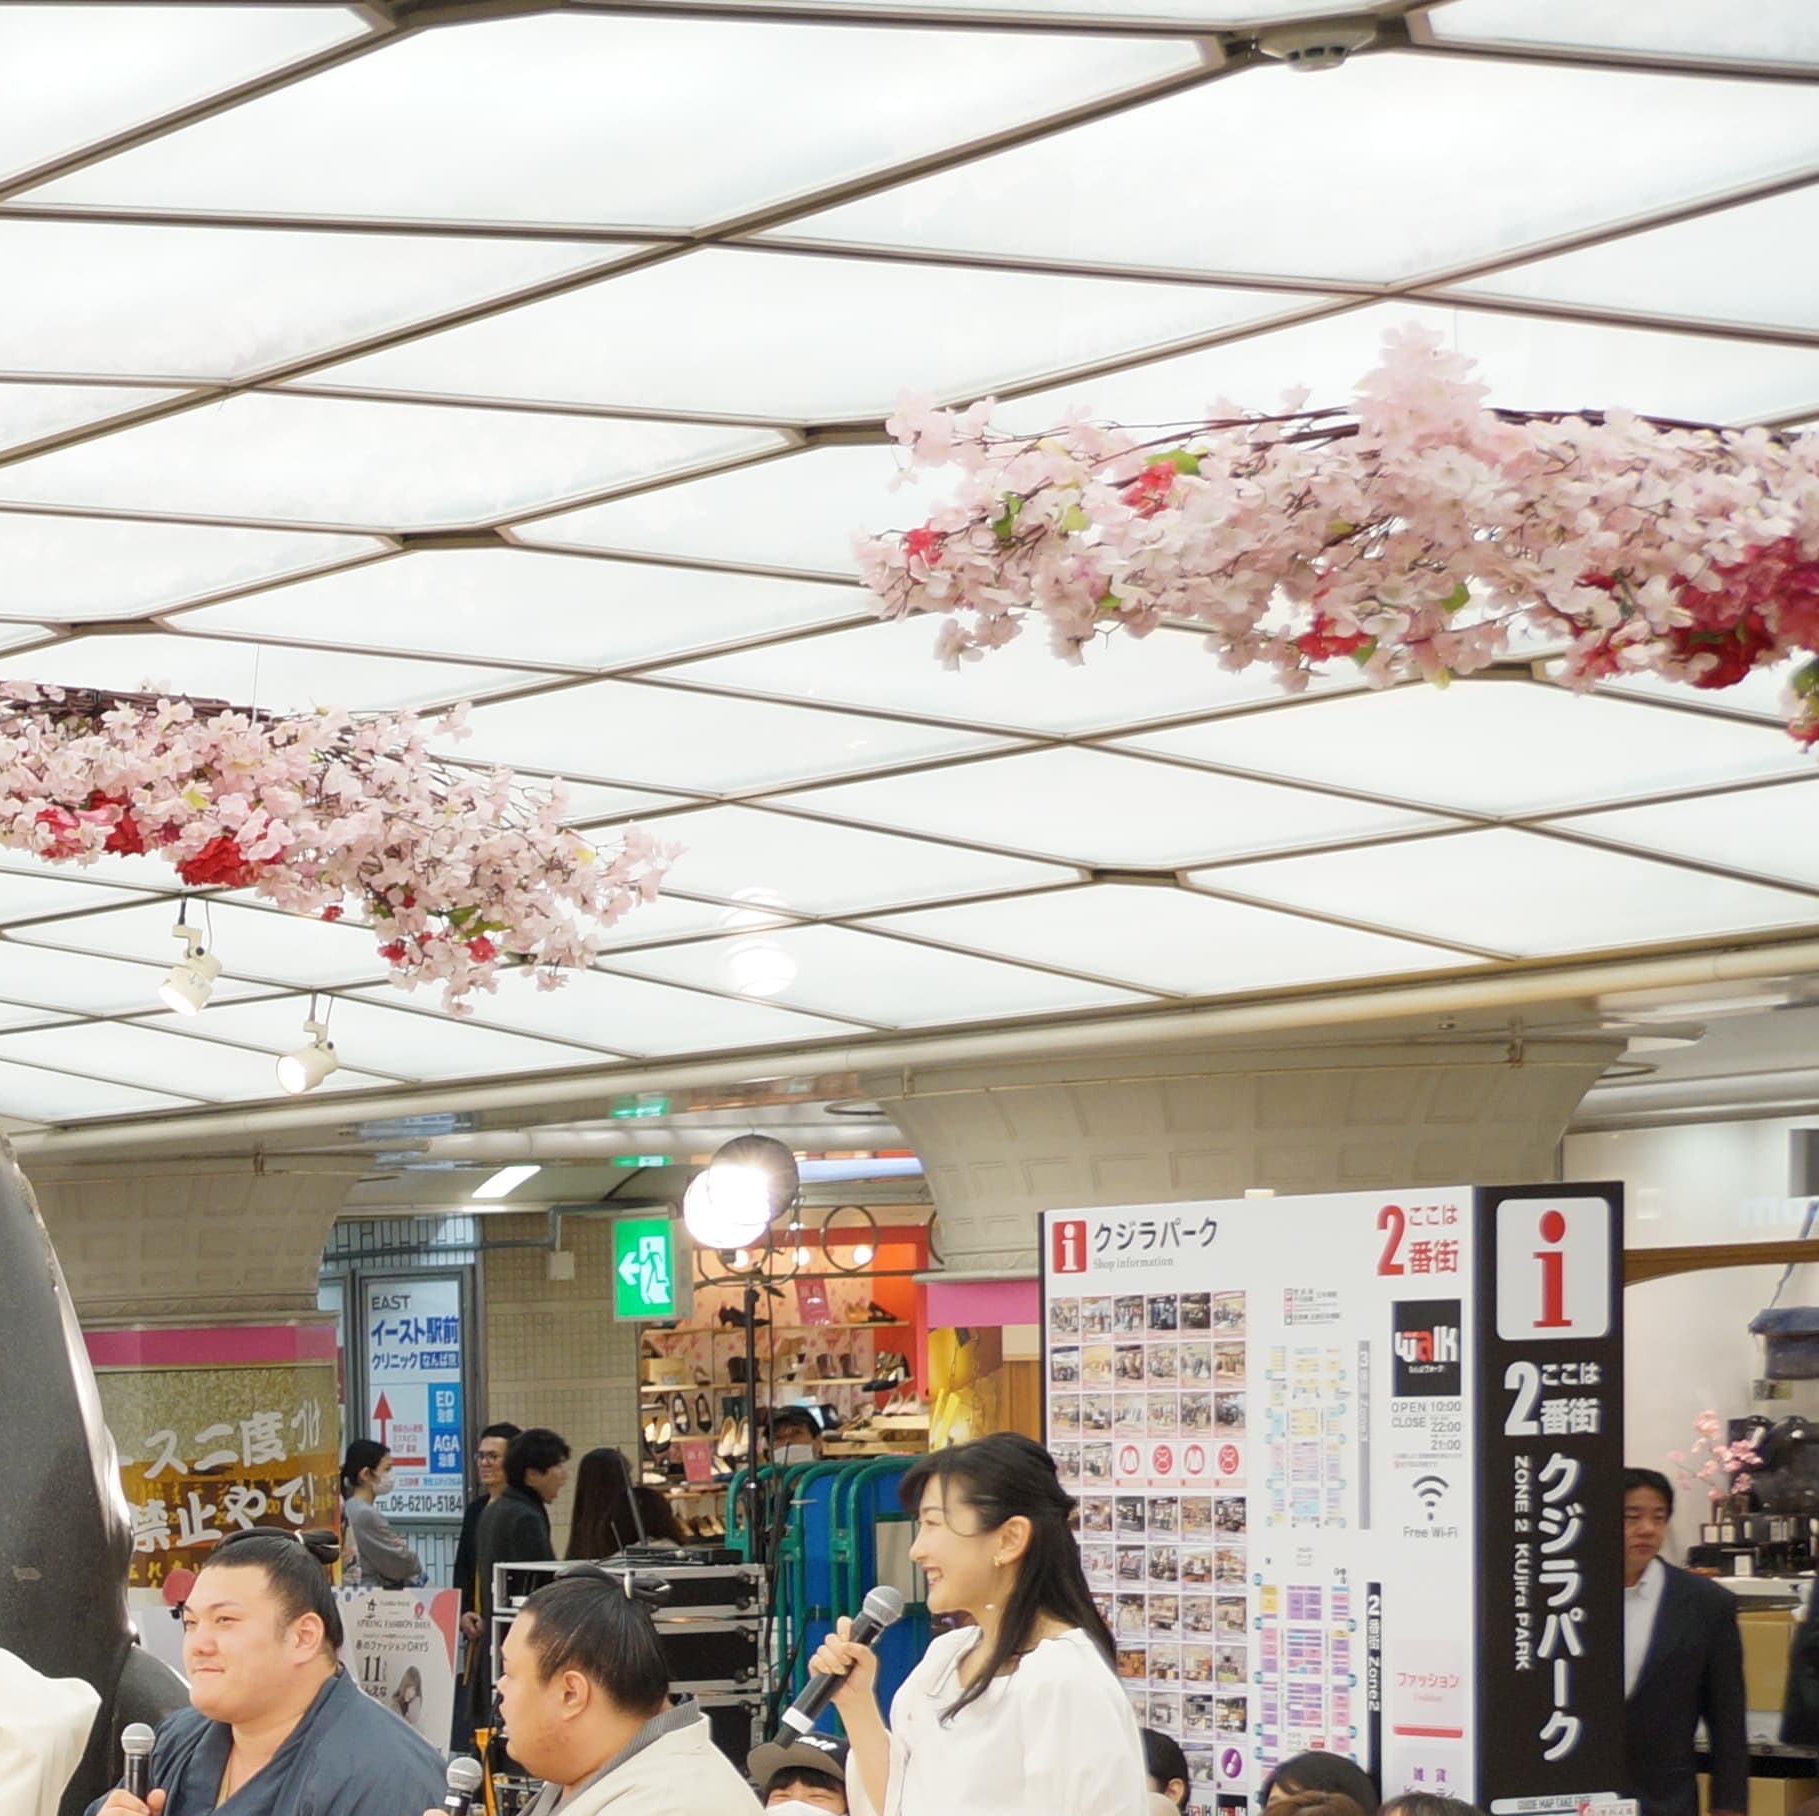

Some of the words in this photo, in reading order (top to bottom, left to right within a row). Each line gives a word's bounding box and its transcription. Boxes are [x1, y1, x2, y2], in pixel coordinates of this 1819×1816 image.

[1409, 1205, 1458, 1225] ここは
[1094, 1218, 1217, 1252] クジラパーク
[1093, 1259, 1114, 1271] Shop
[1117, 1256, 1174, 1268] information
[372, 1295, 411, 1311] EAST
[371, 1315, 459, 1346] イースト駅前
[372, 1352, 418, 1370] クリニック
[1541, 1363, 1601, 1386] ここは
[435, 1391, 455, 1407] ED
[1391, 1402, 1426, 1413] OPEN
[1430, 1401, 1461, 1412] 10:00
[1391, 1417, 1426, 1428] CLOSE
[1430, 1422, 1461, 1433] 22:00
[1540, 1398, 1600, 1435] 番街
[433, 1435, 460, 1452] AGA
[1430, 1440, 1461, 1450] 21:00
[1515, 1455, 1529, 1513] ZONE
[1403, 1526, 1428, 1538] Free
[1431, 1526, 1458, 1538] Wi-Fi
[1537, 1452, 1585, 1761] クジラパーク
[1515, 1611, 1531, 1670] PARK
[1396, 1672, 1459, 1688] ファッション
